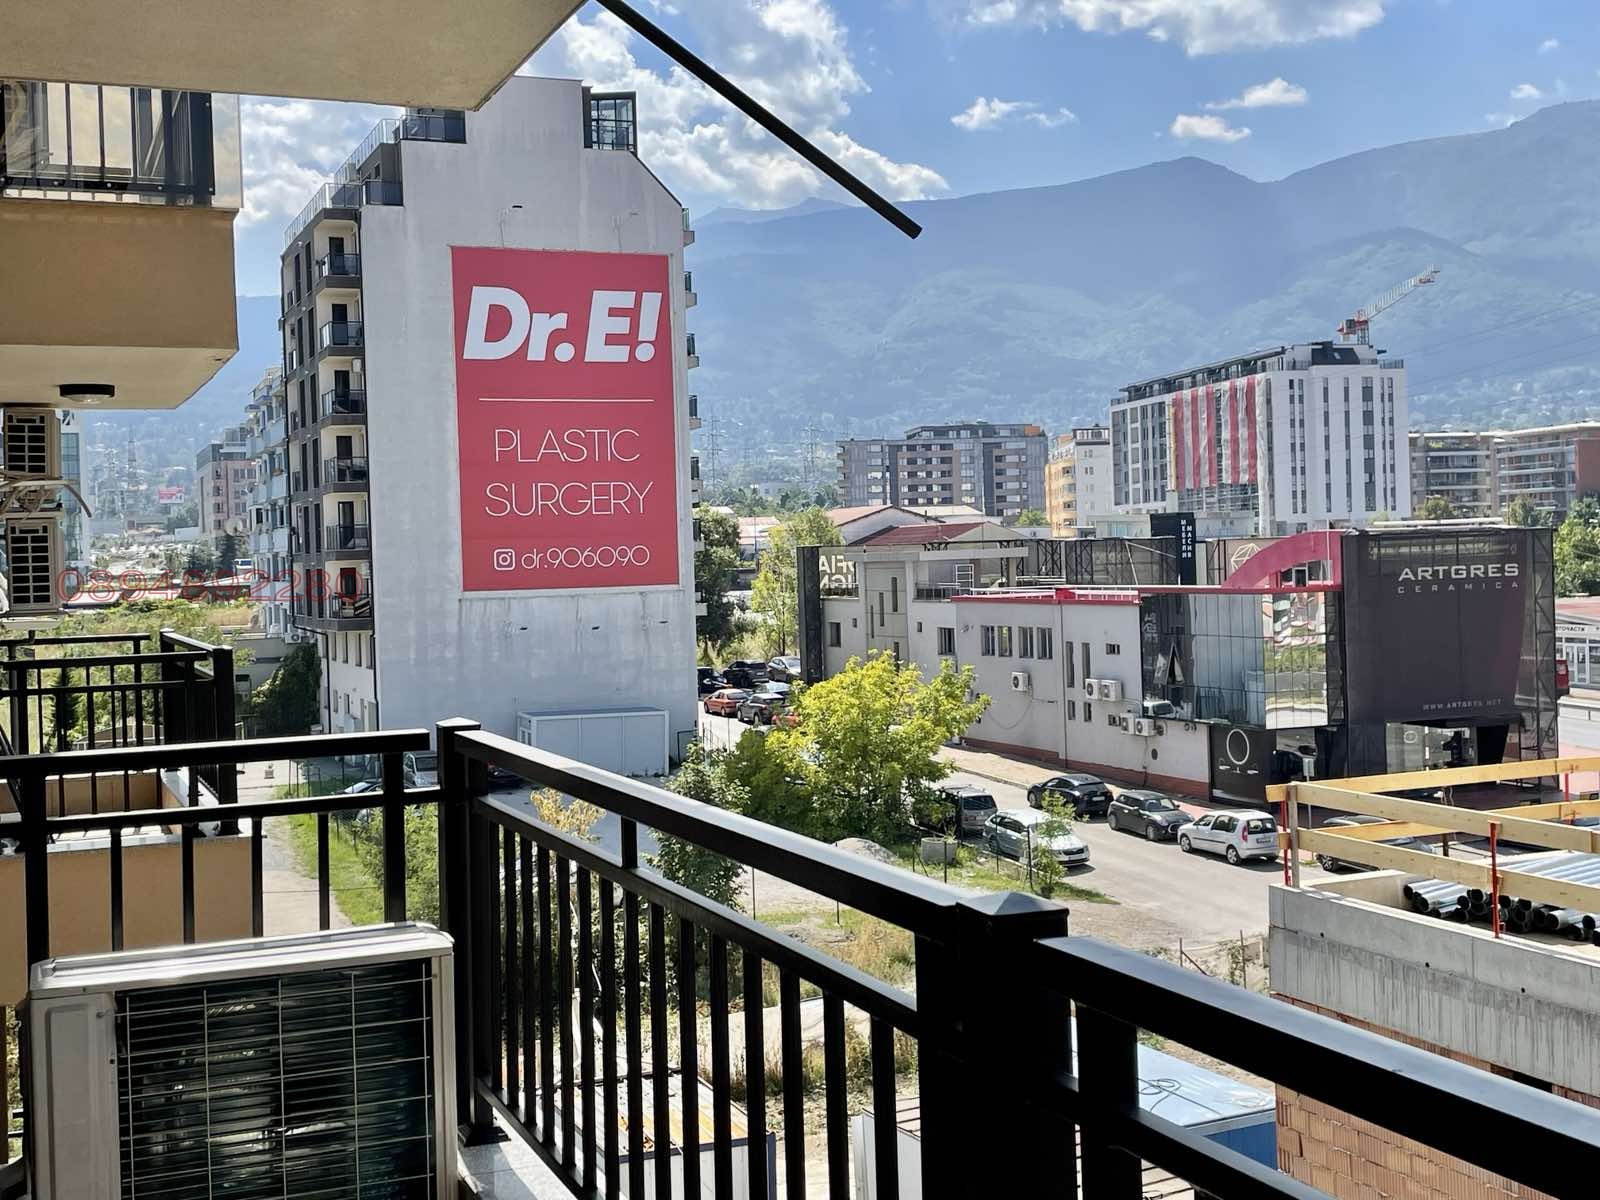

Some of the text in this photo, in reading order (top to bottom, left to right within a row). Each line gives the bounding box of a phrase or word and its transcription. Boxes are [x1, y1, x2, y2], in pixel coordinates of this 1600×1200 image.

[463, 285, 663, 363] Dr.E!
[495, 429, 641, 463] PLASTIC
[485, 481, 654, 517] SURGERY
[521, 545, 650, 569] dr.906090
[1398, 563, 1520, 582] ARTGRES
[1398, 581, 1519, 594] CERAMICA
